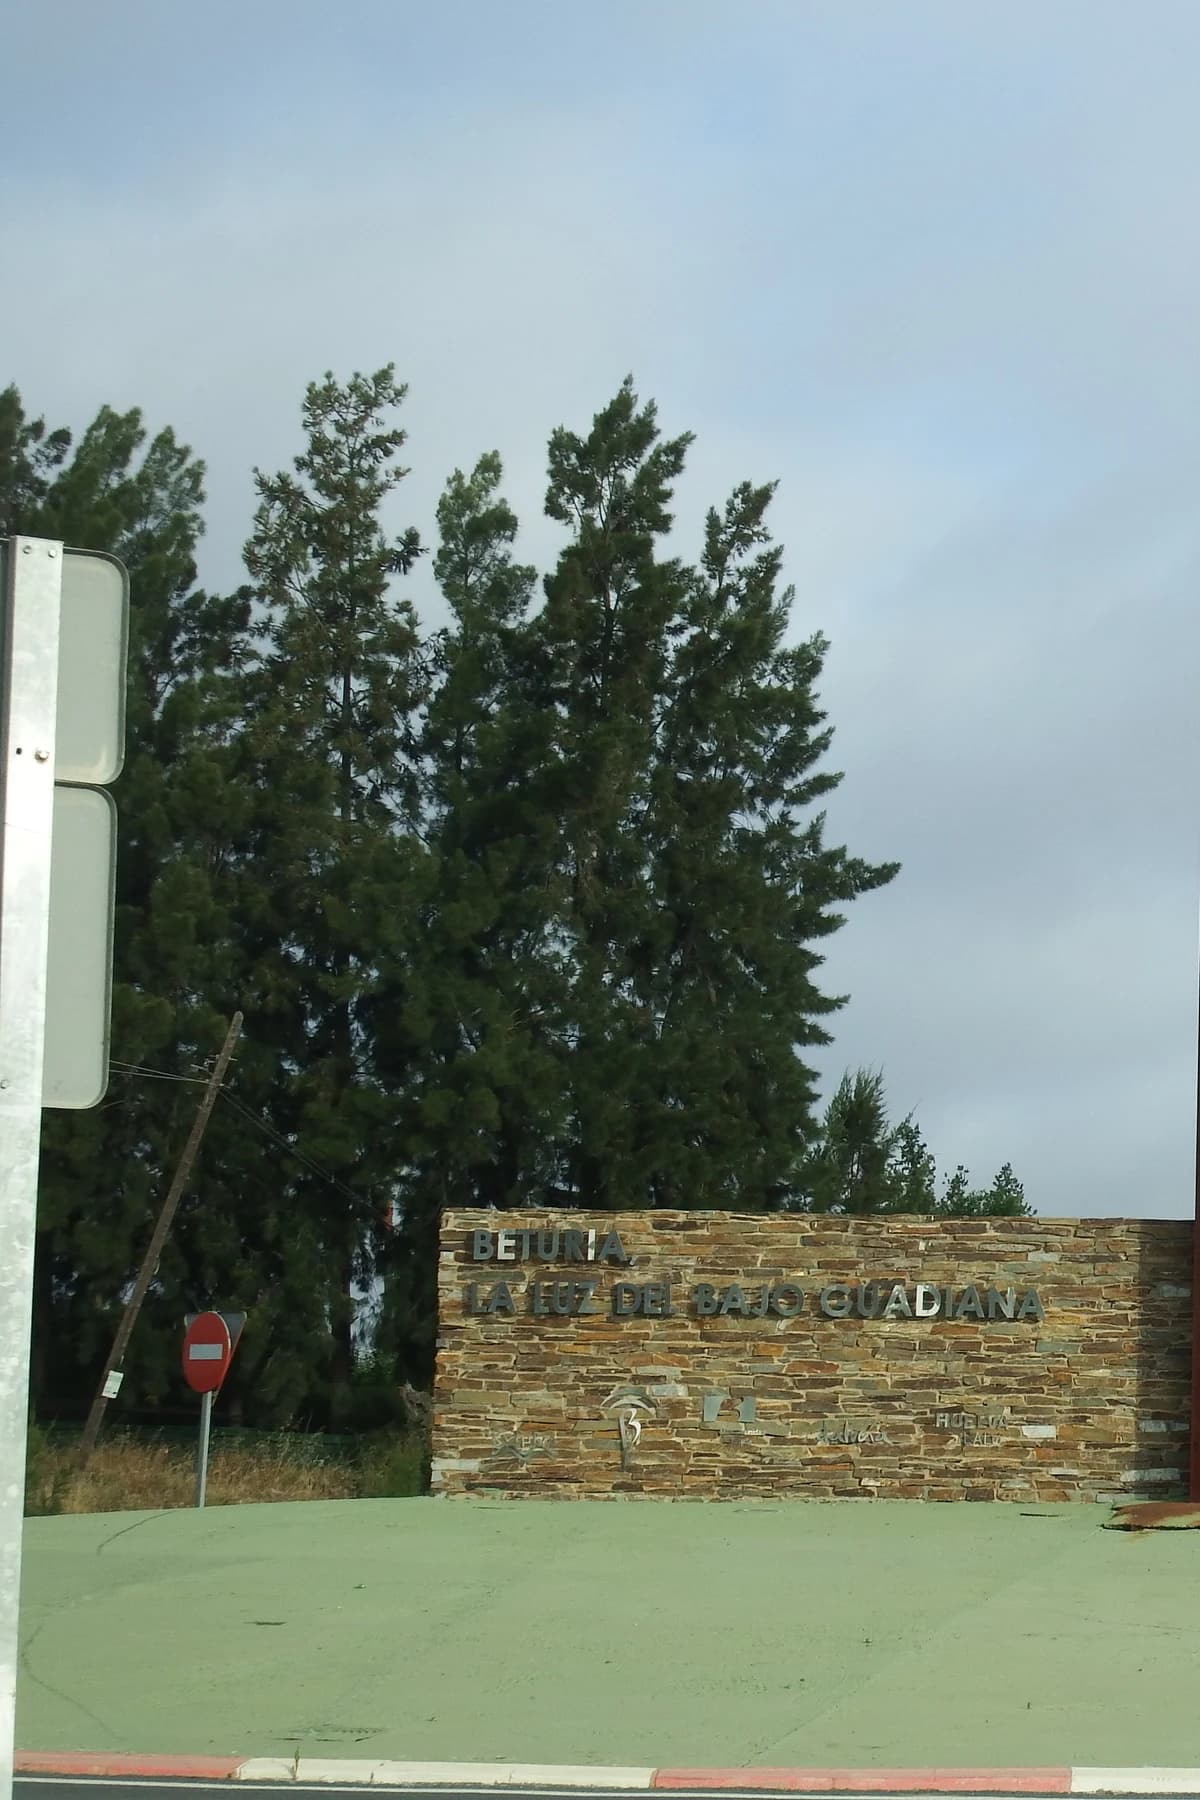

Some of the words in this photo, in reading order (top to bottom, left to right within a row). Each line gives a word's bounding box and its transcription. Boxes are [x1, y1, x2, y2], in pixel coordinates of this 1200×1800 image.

[473, 1229, 637, 1266] BETURIA,
[470, 1281, 516, 1314] LA
[533, 1281, 599, 1314] LUZ
[616, 1282, 672, 1315] DEL
[695, 1283, 804, 1317] BAJO
[820, 1283, 1046, 1319] GUADIANA
